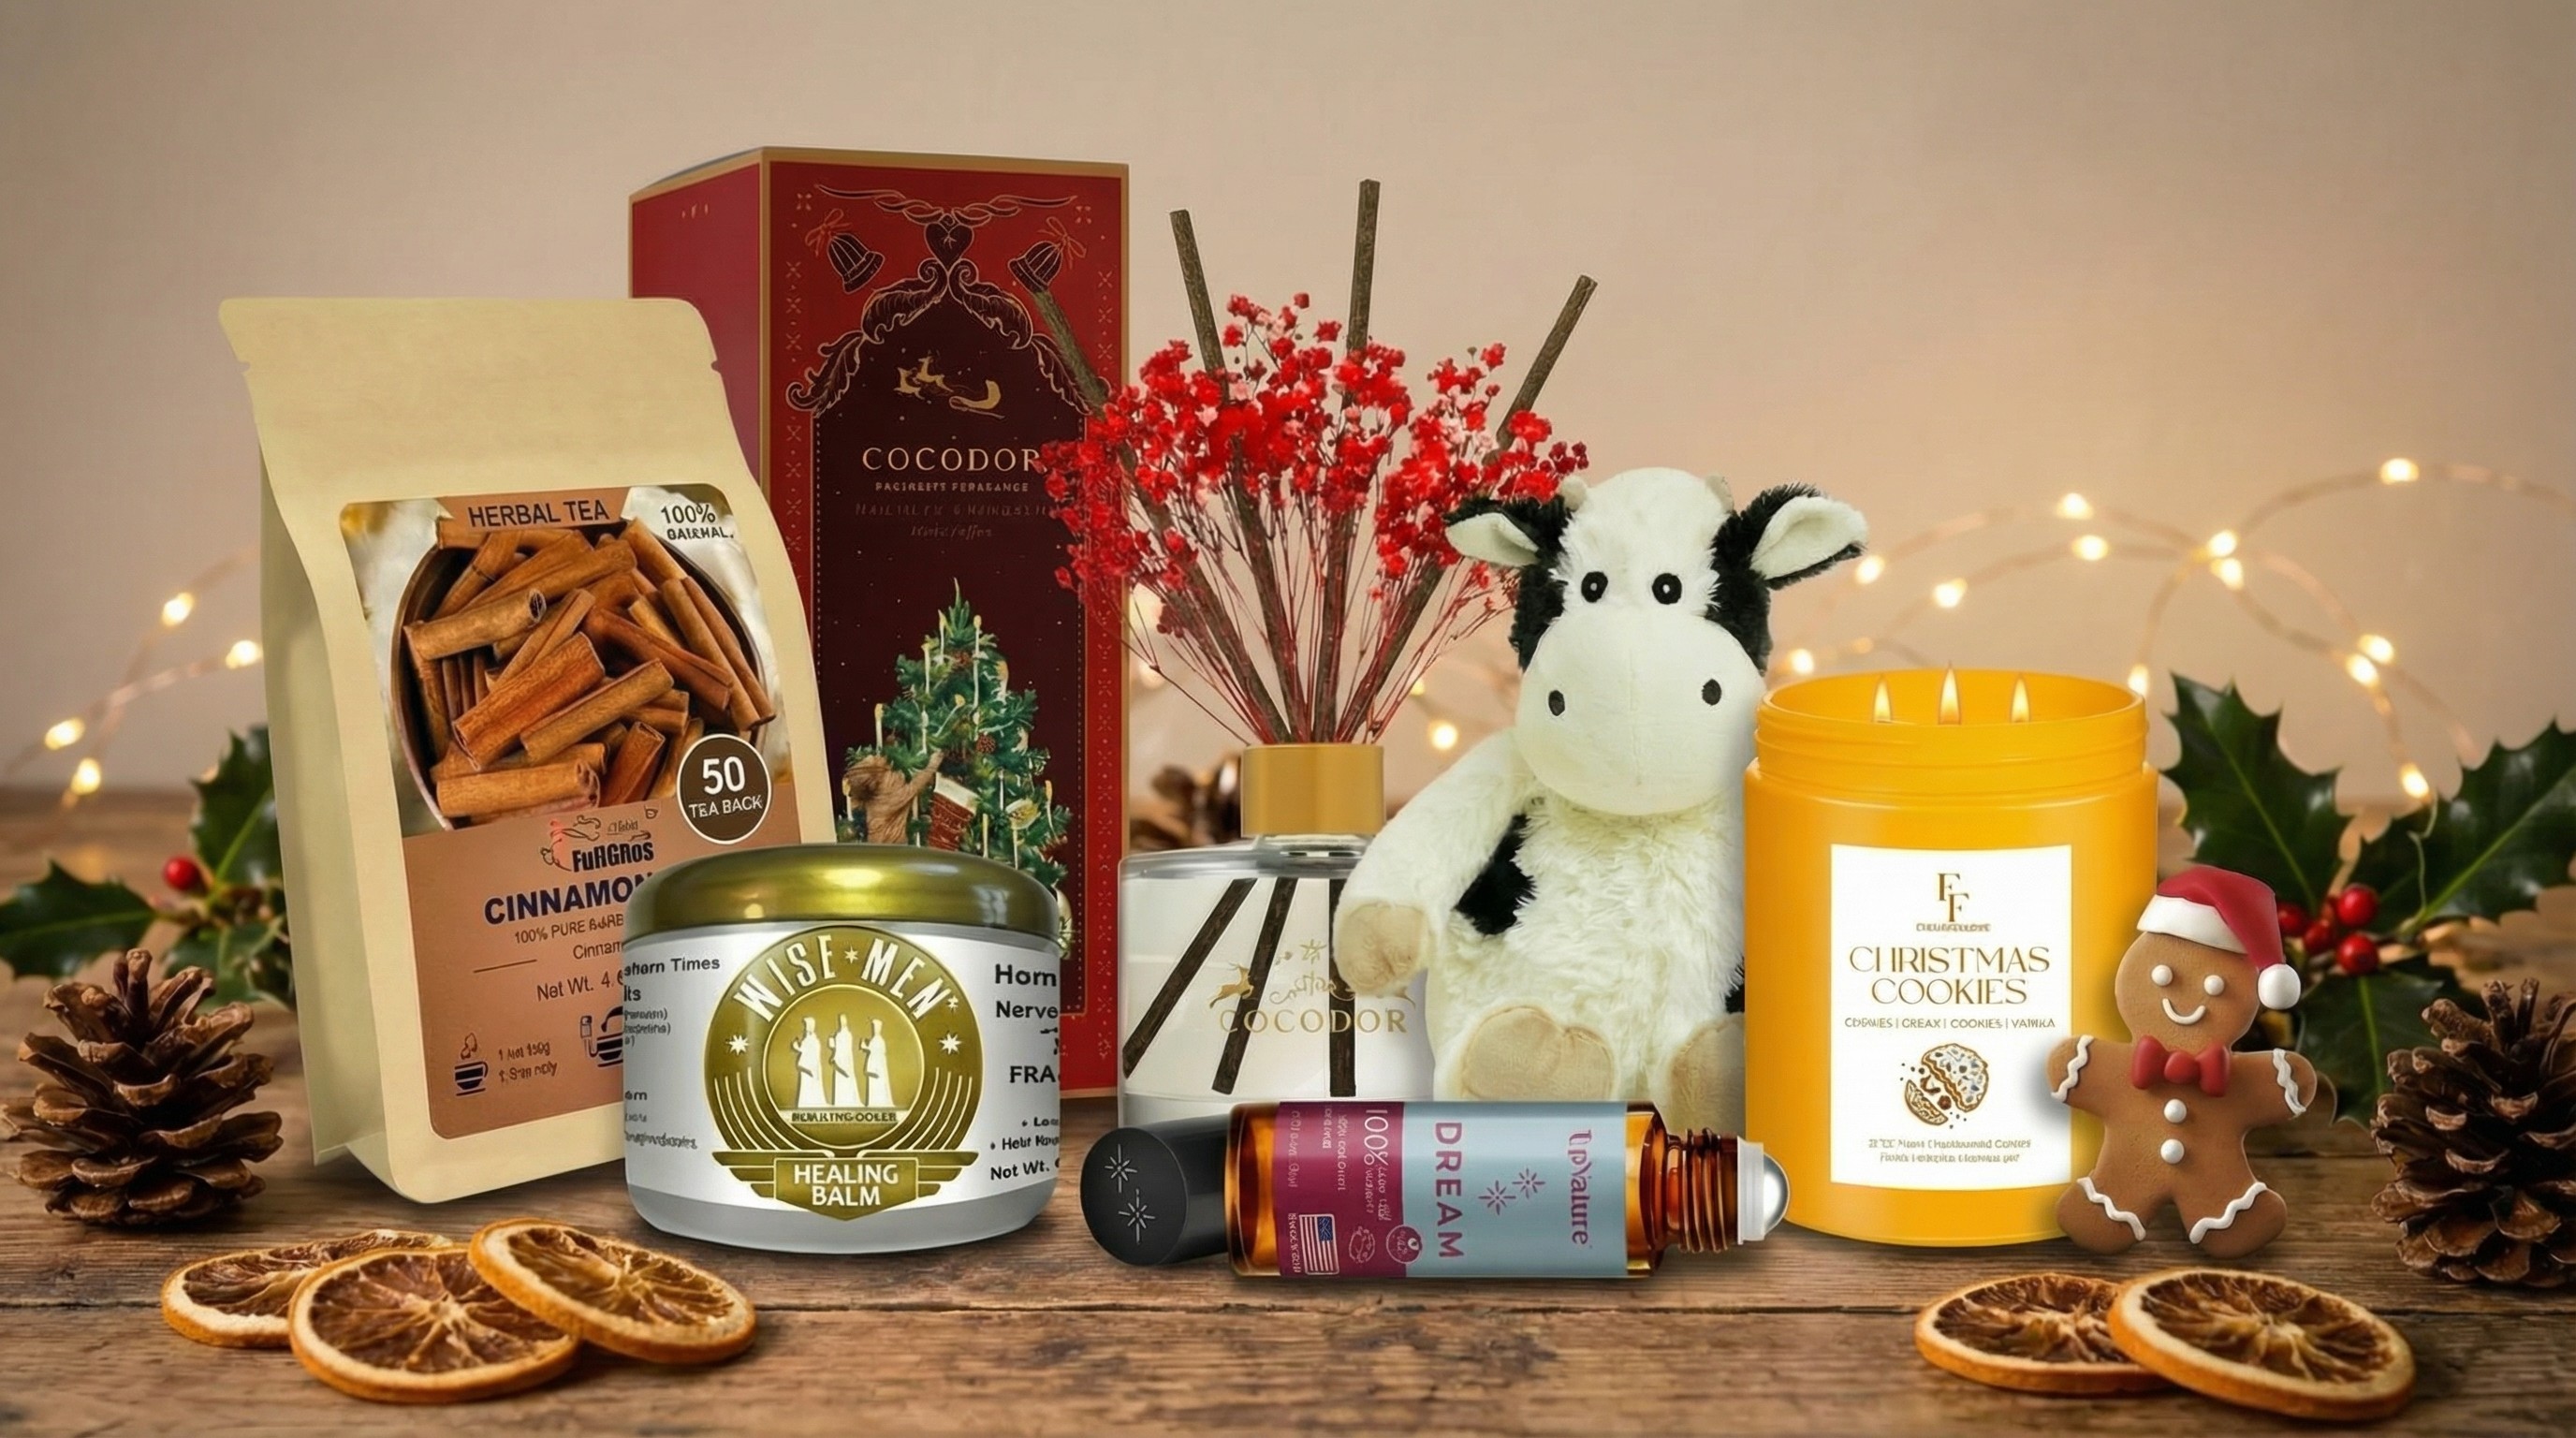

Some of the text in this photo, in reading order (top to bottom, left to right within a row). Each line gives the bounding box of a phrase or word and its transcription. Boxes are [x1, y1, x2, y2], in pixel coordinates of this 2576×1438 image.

[862, 447, 1047, 473] COCODOR
[467, 499, 610, 528] HERBAL TEA
[660, 503, 716, 524] 100%
[702, 755, 746, 795] 50
[688, 794, 763, 819] TEA BACK
[515, 927, 549, 945] 100%
[550, 919, 585, 937] PURE
[670, 957, 721, 972] Times
[1849, 946, 2051, 974] CHRISTMAS
[566, 976, 594, 995] Wt.
[733, 933, 949, 1023] WISE MEN
[1871, 977, 2028, 1005] COOKIES
[996, 1000, 1059, 1019] Nerve
[1220, 1008, 1408, 1034] COCODOR
[1010, 1064, 1061, 1084] FRA
[1362, 1108, 1390, 1167] 100%
[794, 1164, 899, 1185] HEALING
[1023, 1159, 1050, 1176] Wt.
[812, 1185, 882, 1207] BALM
[1433, 1121, 1465, 1258] DREAM
